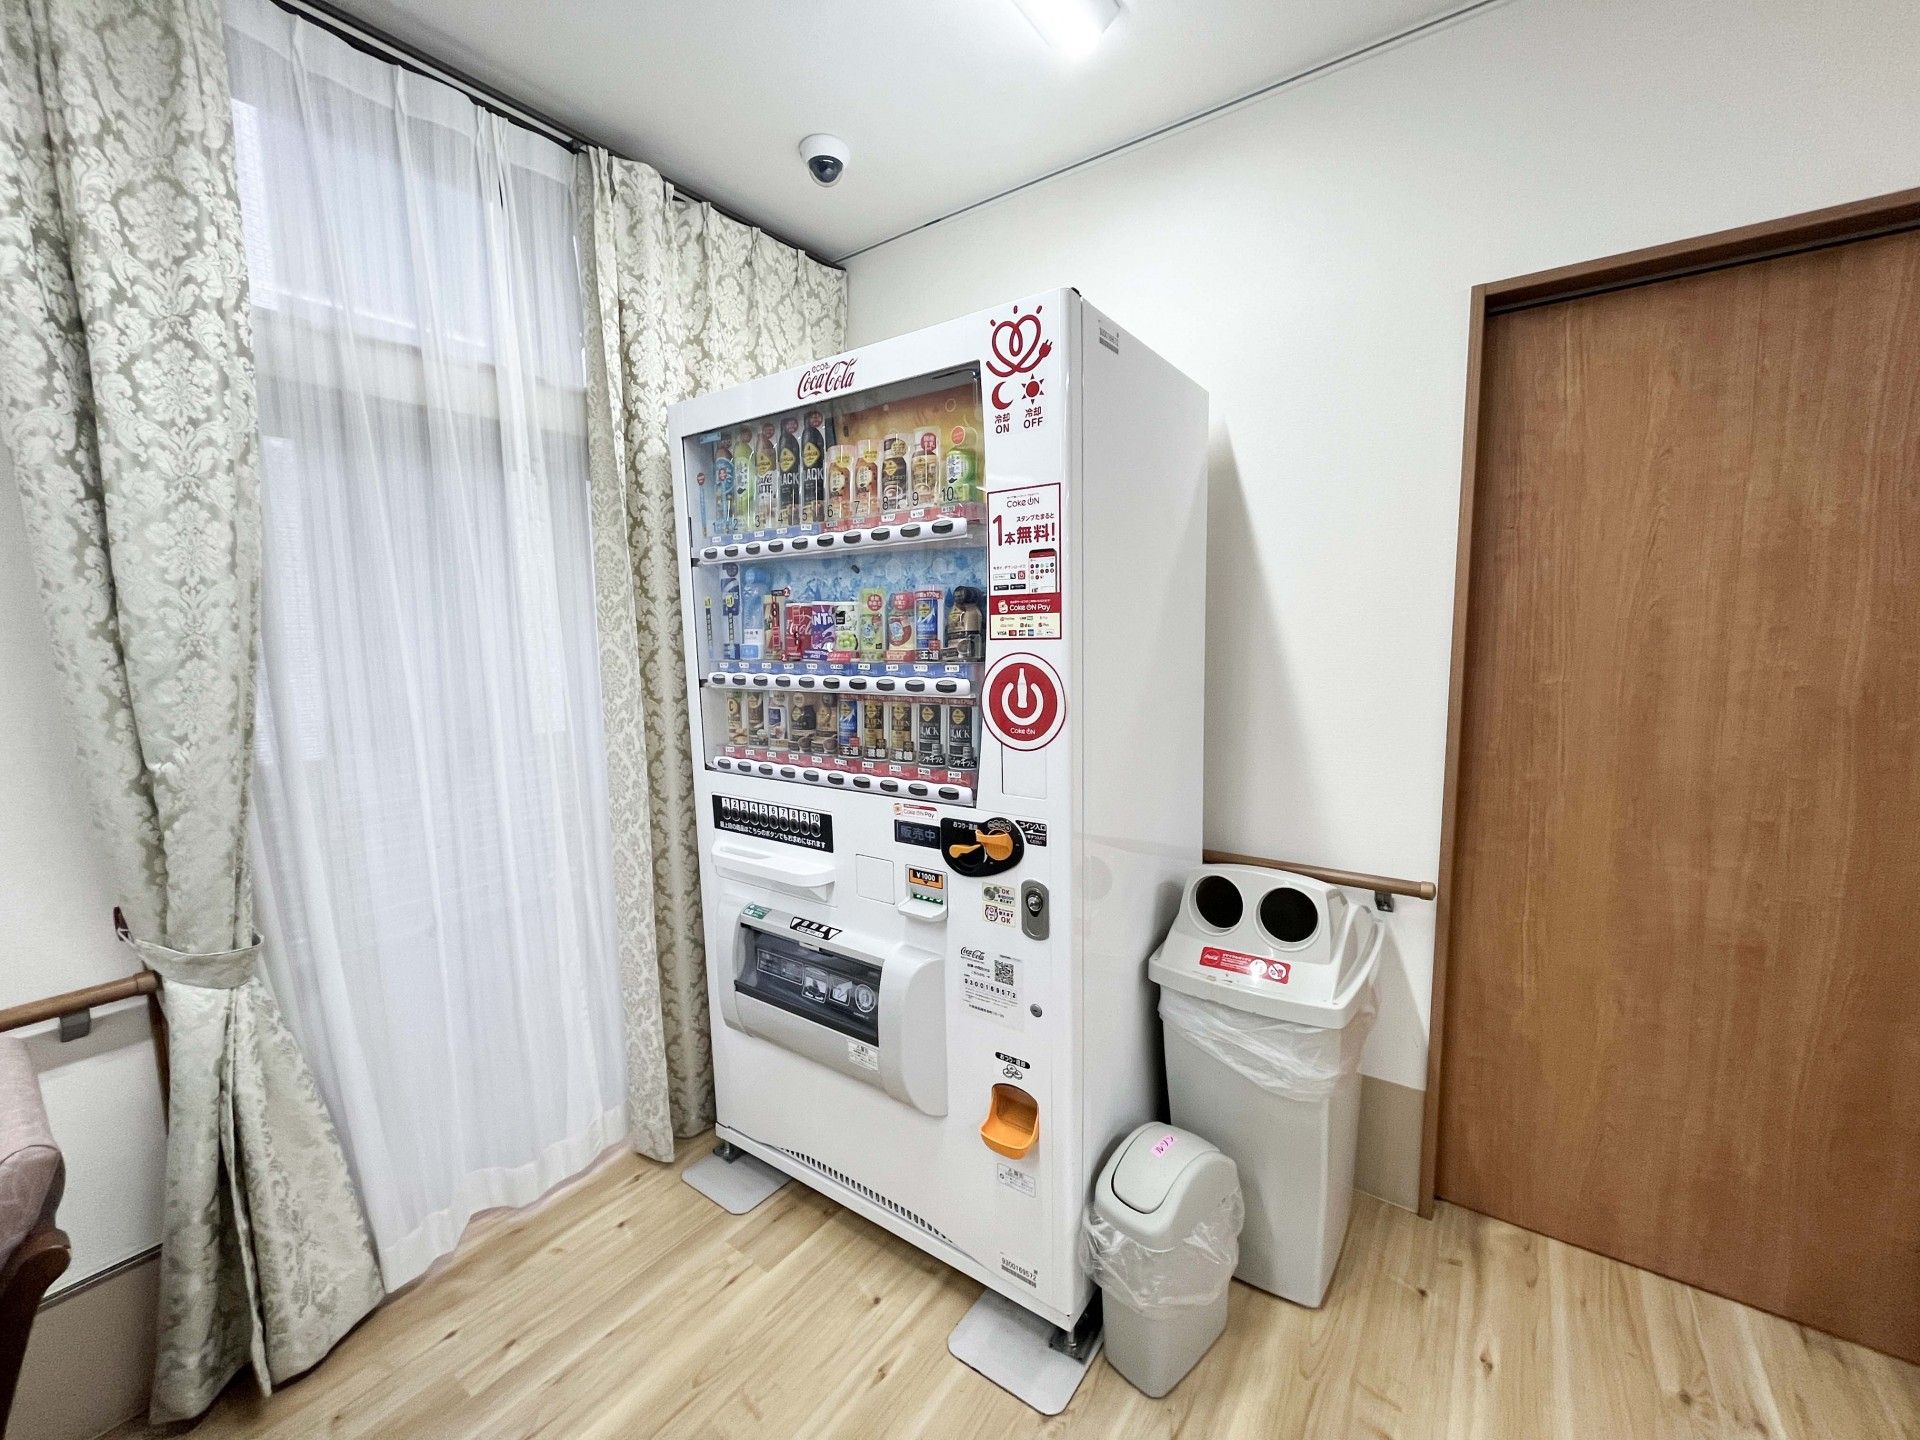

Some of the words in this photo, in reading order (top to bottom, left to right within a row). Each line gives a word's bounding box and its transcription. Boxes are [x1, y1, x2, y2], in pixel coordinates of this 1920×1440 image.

[797, 358, 859, 400] Coca-Cola
[1025, 406, 1041, 418] 冷却
[994, 413, 1010, 424] 冷却
[1023, 416, 1043, 429] OFF
[995, 423, 1010, 434] ON
[1006, 499, 1027, 508] Coke
[1016, 512, 1055, 522] スタンプたまると
[992, 514, 1056, 546] 1本無料!
[1009, 603, 1026, 611] Coke
[1026, 603, 1036, 611] ON
[1037, 603, 1051, 611] Pay
[1010, 727, 1026, 735] Coke
[781, 808, 786, 816] 7
[791, 810, 796, 818] 8
[812, 814, 819, 822] 10
[1020, 821, 1047, 832] コイン入口
[900, 826, 937, 843] 販売中
[1000, 916, 1011, 924] OK
[960, 946, 985, 961] Coca-Cola
